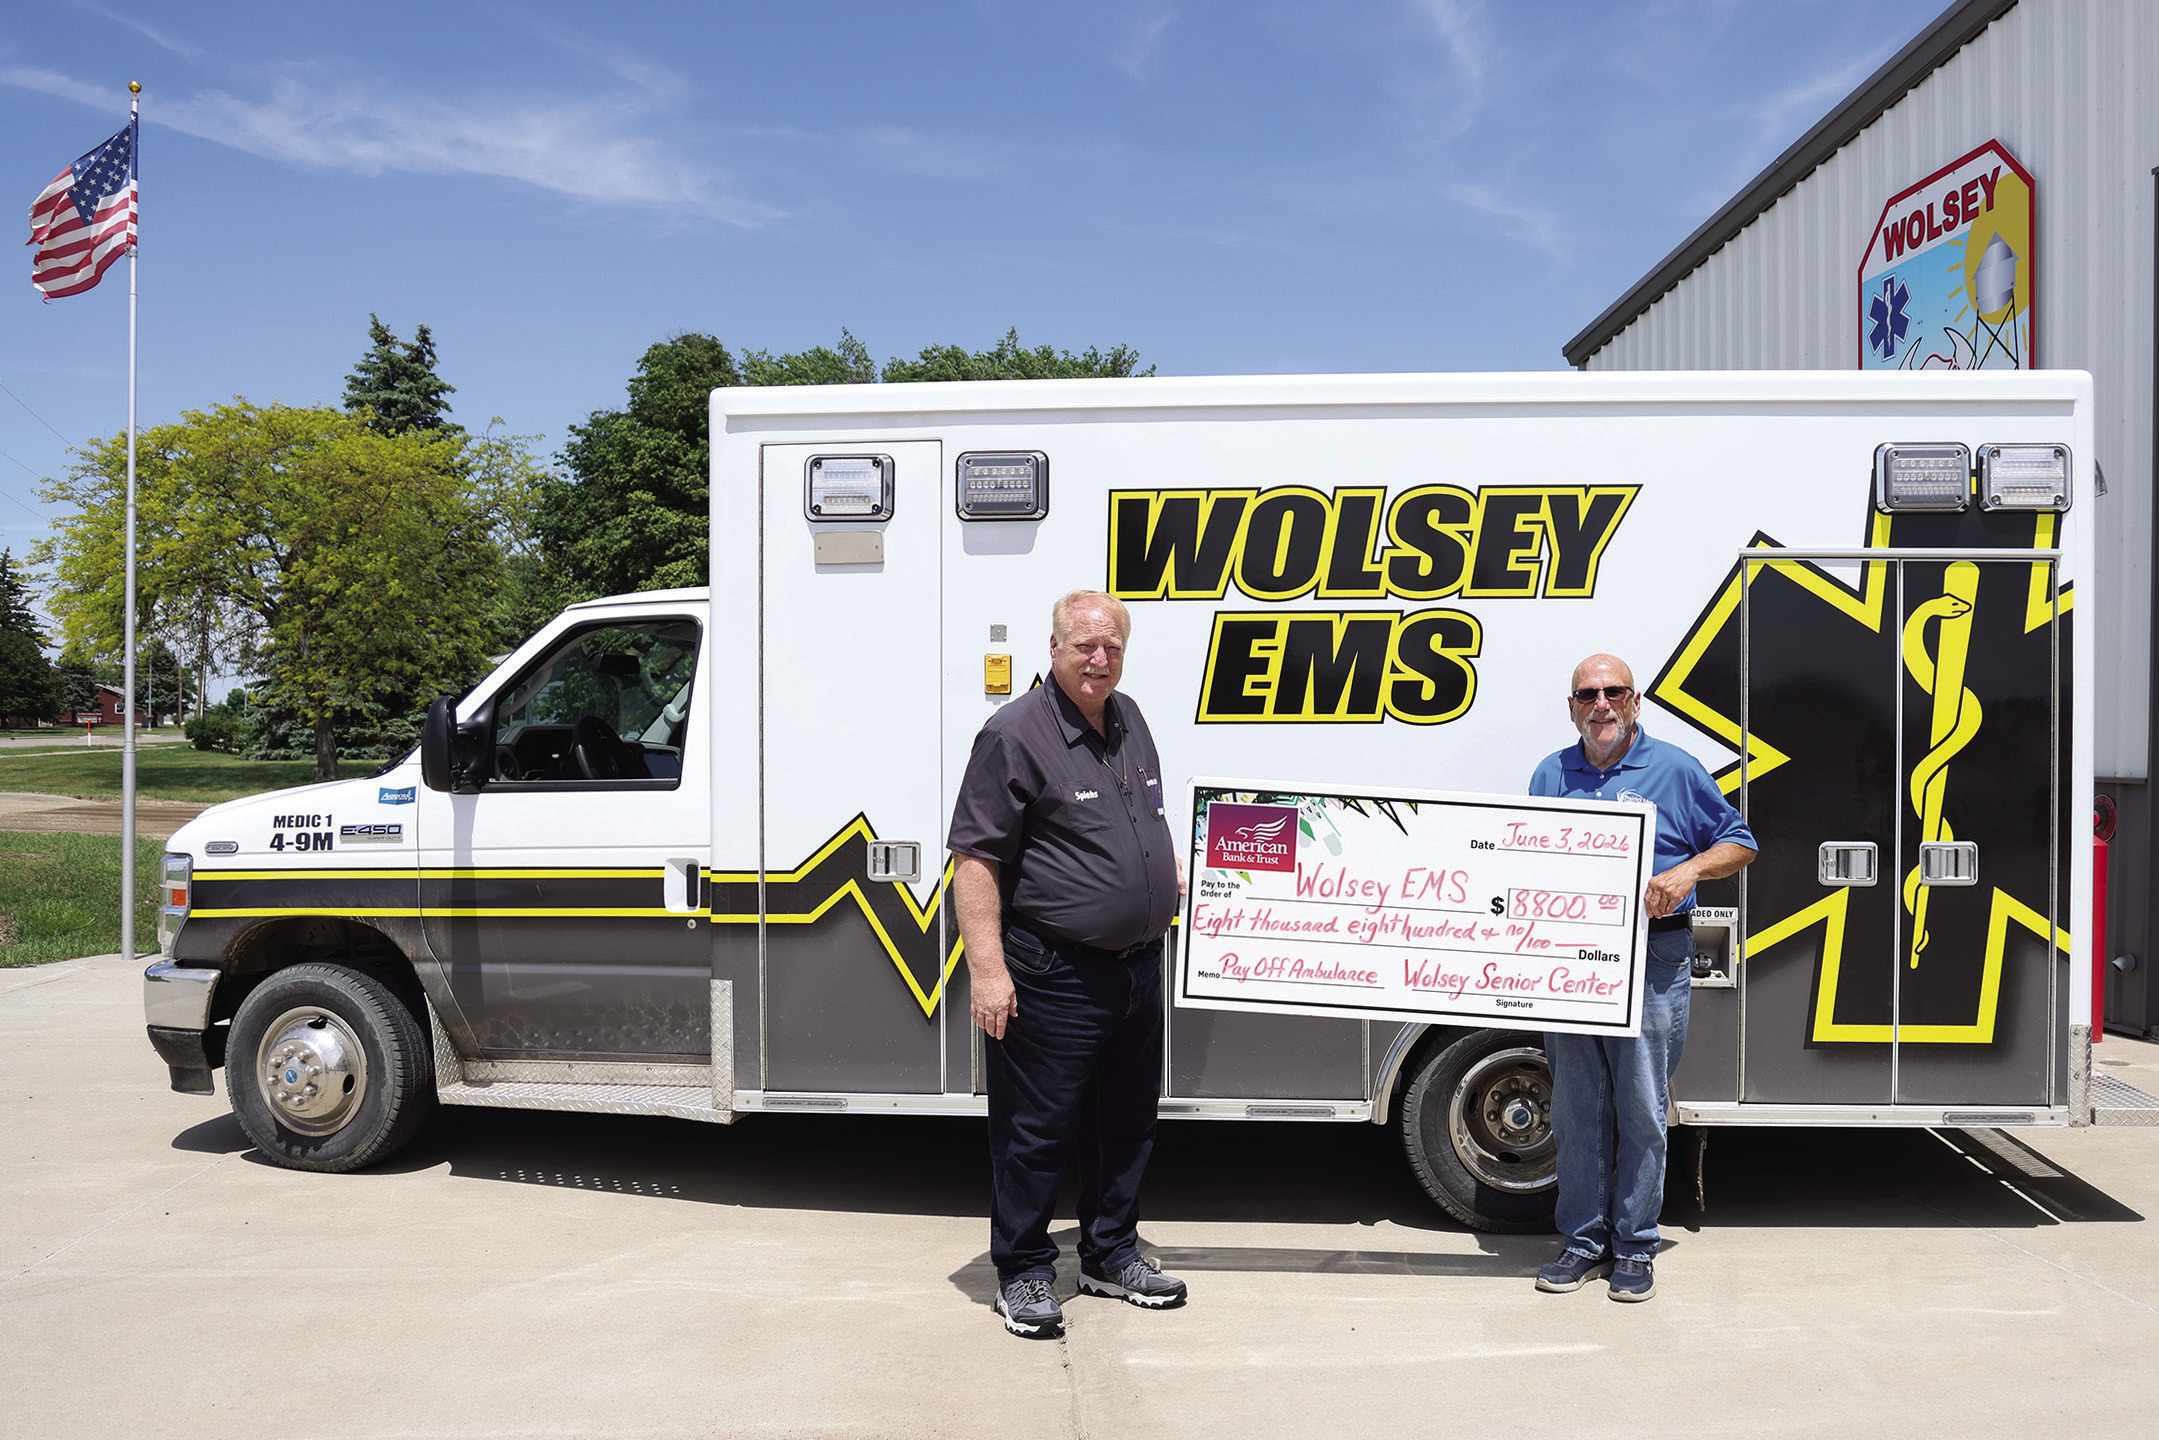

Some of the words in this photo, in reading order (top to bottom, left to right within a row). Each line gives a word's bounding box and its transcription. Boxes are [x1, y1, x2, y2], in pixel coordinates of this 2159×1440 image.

[1882, 165, 2001, 262] WOLSEY
[1107, 484, 1643, 601] WOLSEY
[1195, 608, 1483, 726] EMS
[273, 815, 321, 828] MEDIC
[326, 814, 332, 827] 1
[270, 832, 334, 851] 4-9M
[1215, 836, 1288, 855] American
[1471, 840, 1495, 850] Date
[1502, 823, 1550, 849] June
[1555, 828, 1573, 852] 3,
[1577, 832, 1629, 851] 2026
[1222, 853, 1247, 863] Bank
[1255, 854, 1279, 865] Trust
[1200, 890, 1222, 898] Order
[1223, 890, 1232, 898] of
[1201, 880, 1215, 890] Pay
[1217, 881, 1225, 889] to
[1227, 881, 1240, 889] the
[1296, 862, 1391, 915] Wolsey
[1401, 867, 1469, 903] EMS
[1490, 896, 1505, 916] $
[1691, 910, 1712, 918] ADED
[1714, 910, 1733, 918] ONLY
[1192, 904, 1244, 939] Eight
[1250, 908, 1339, 933] thousand
[1578, 950, 1620, 962] Dollars
[1198, 970, 1220, 979] Memo
[1218, 953, 1250, 984] Pay
[1254, 957, 1290, 979] Off
[1288, 958, 1378, 984] Ambulance
[1404, 959, 1471, 1001] Wolsey
[1475, 962, 1543, 992] Senior
[1548, 967, 1623, 996] Center
[1496, 999, 1533, 1009] Signature
